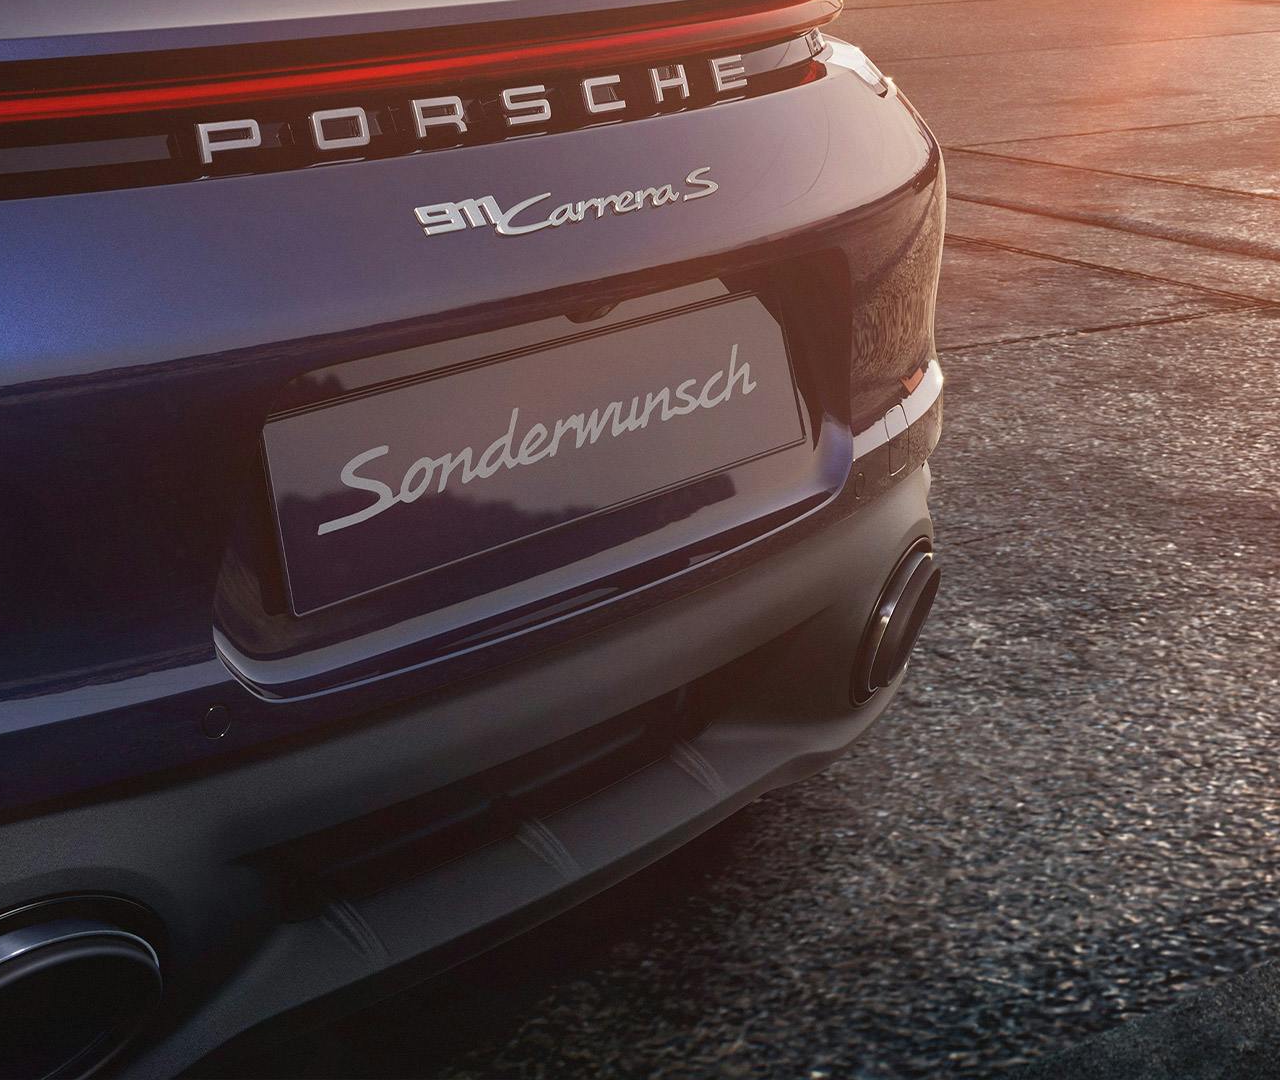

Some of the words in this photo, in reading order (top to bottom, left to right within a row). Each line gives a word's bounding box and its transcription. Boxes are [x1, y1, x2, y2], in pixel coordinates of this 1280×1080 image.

[195, 53, 748, 164] PORSCHE
[414, 194, 501, 237] 911
[496, 191, 680, 236] Carrera
[683, 166, 719, 203] S
[317, 344, 758, 536] Sonderwunsch
